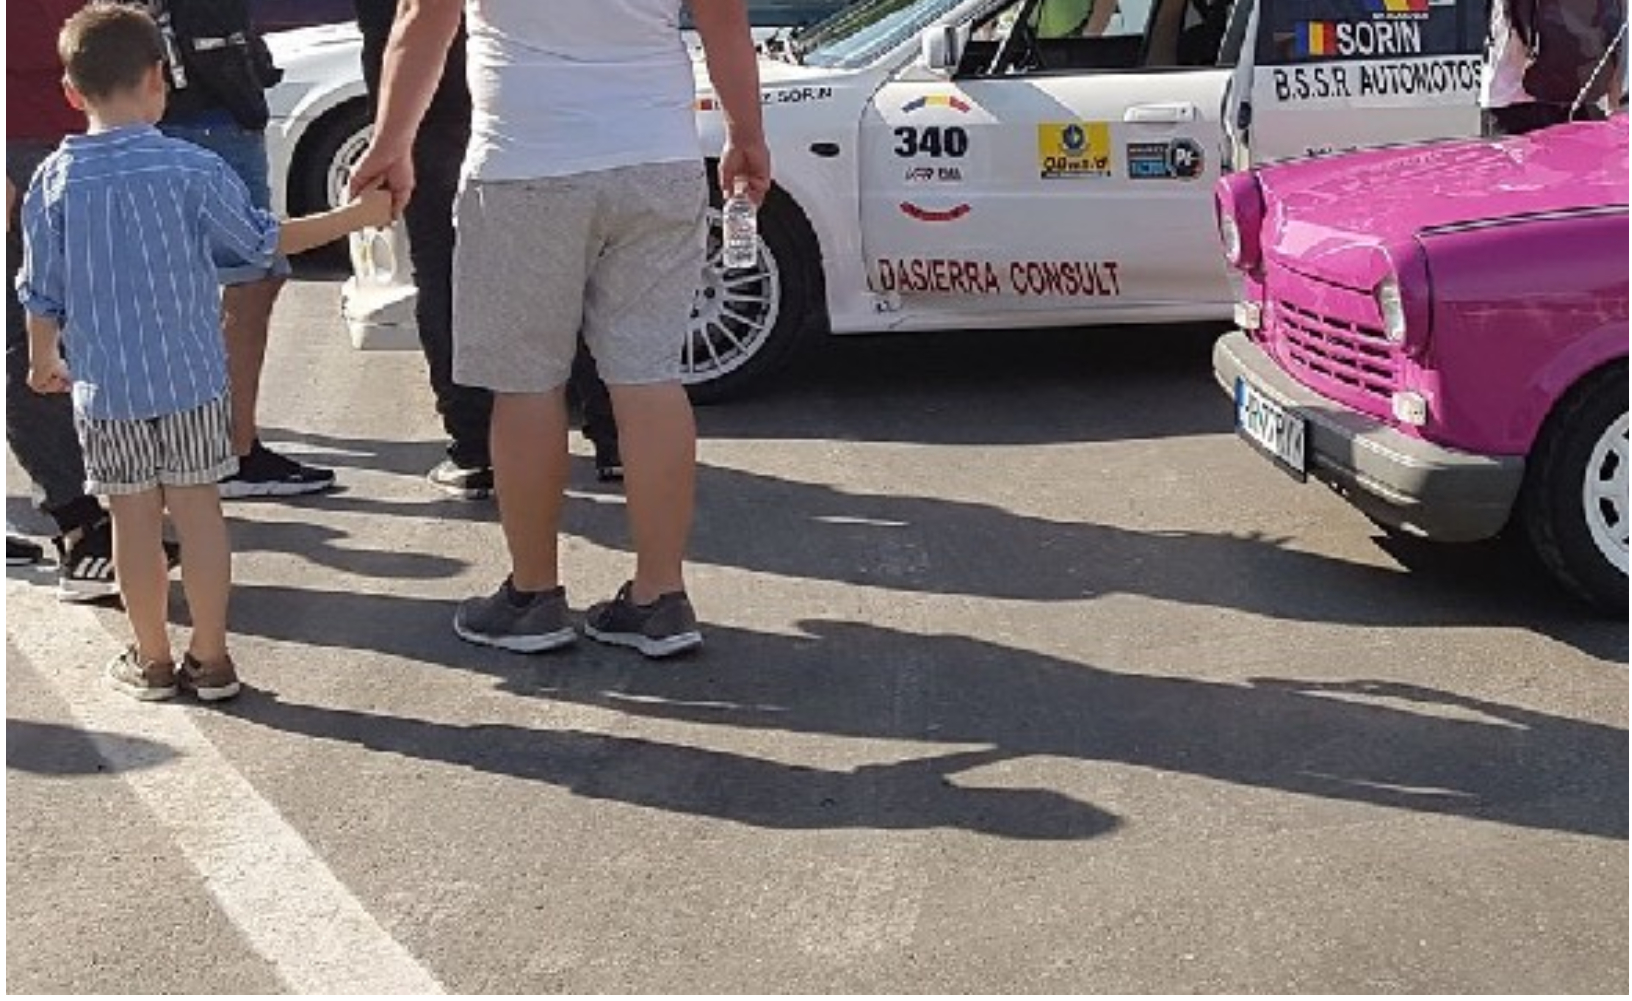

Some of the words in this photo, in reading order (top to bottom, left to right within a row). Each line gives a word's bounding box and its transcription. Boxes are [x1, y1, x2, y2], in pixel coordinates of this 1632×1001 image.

[1337, 20, 1421, 56] SORIN
[894, 126, 968, 158] 340
[878, 258, 1000, 294] DASIERRA
[1009, 261, 1120, 296] CONSULT
